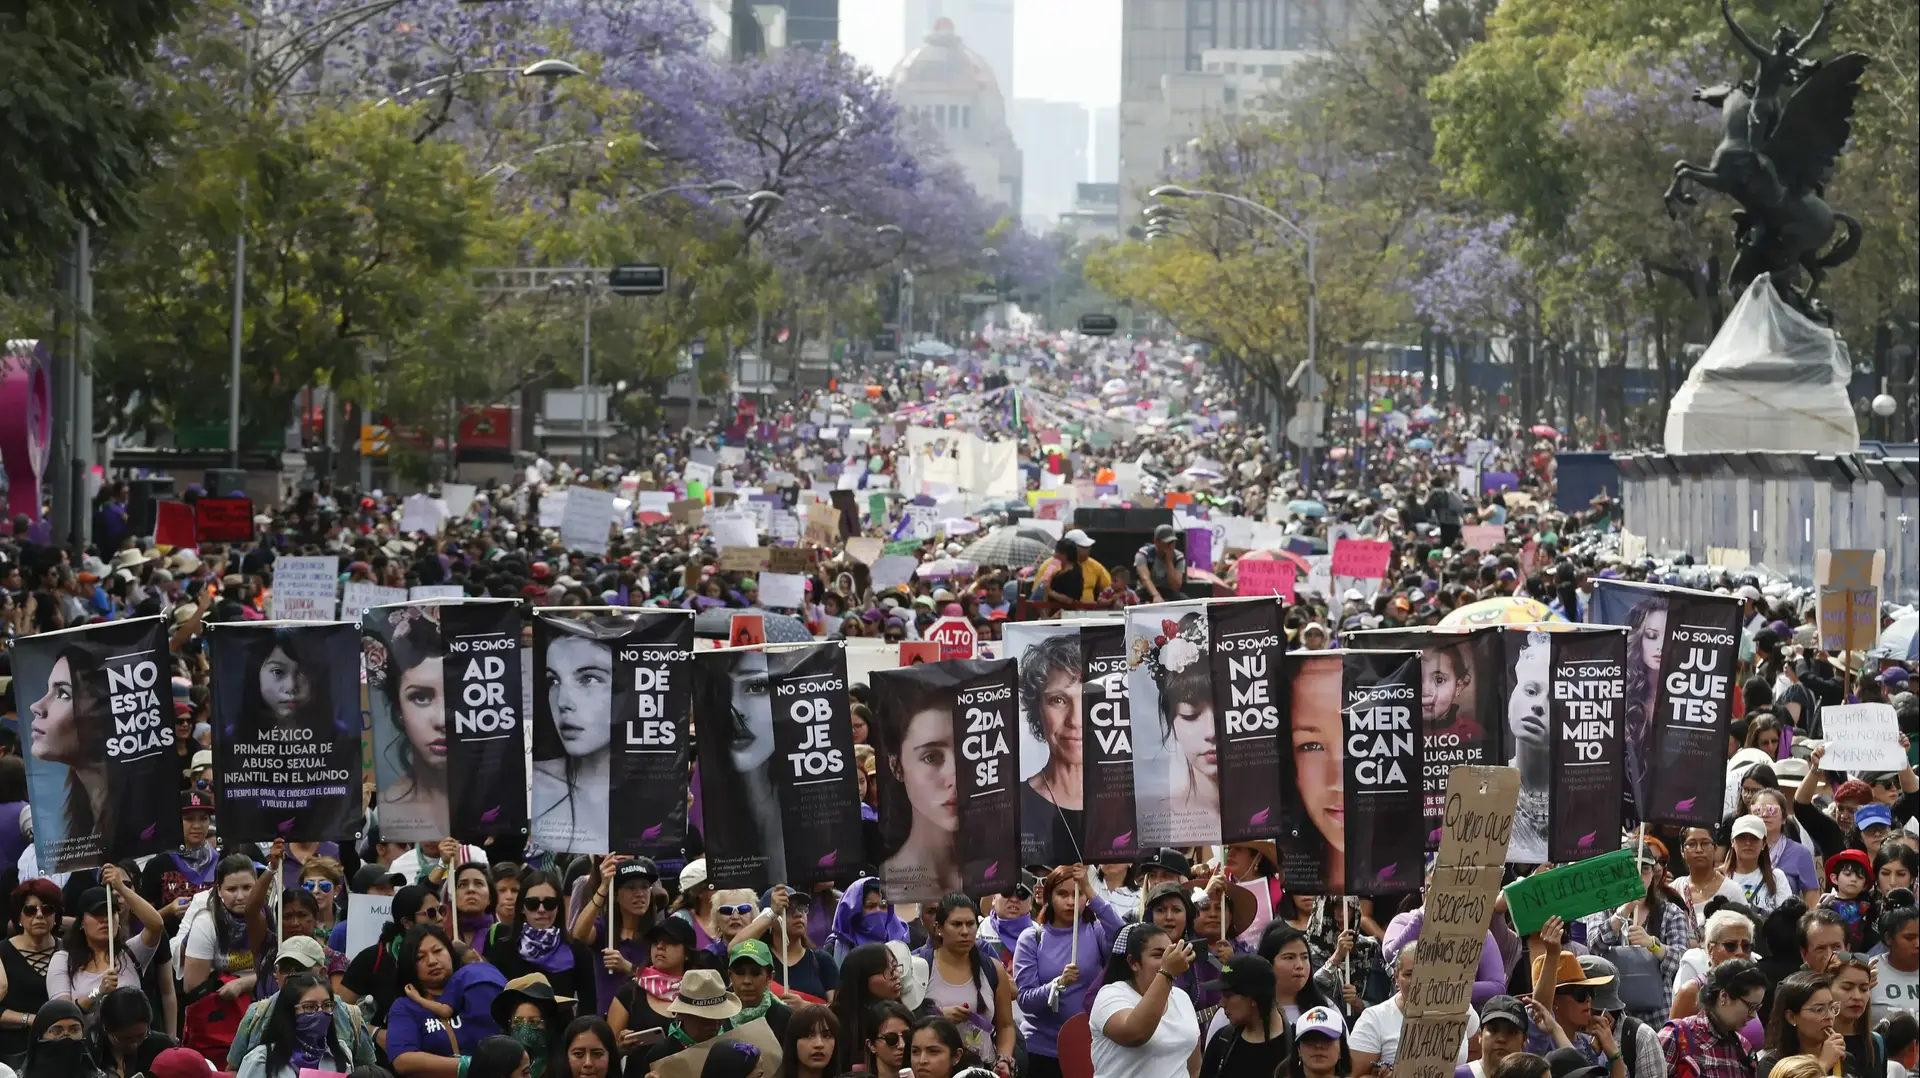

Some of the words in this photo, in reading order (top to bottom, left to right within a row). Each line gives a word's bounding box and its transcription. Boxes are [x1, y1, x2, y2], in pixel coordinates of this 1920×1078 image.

[450, 641, 468, 653] NO
[472, 639, 515, 651] SOMOS
[934, 629, 971, 646] ALTO
[1216, 641, 1234, 652] NO
[1238, 635, 1279, 650] SOMOS
[1671, 630, 1690, 642] NO
[1692, 631, 1735, 646] SOMOS
[620, 650, 639, 661] NO
[642, 650, 686, 661] SOMOS
[1089, 661, 1107, 673] NO
[1229, 648, 1267, 681] NÚ
[1679, 647, 1718, 672] JU
[106, 660, 158, 694] NO
[463, 656, 506, 681] AD
[635, 663, 670, 691] DÉ
[1557, 666, 1576, 678] NO
[1579, 666, 1621, 677] SOMOS
[463, 682, 506, 707] OR
[777, 684, 795, 696] NO
[799, 679, 843, 694] SOMOS
[957, 694, 973, 705] NO
[977, 687, 1011, 703] SOMOS
[1231, 680, 1270, 707] ME
[1348, 690, 1366, 702] NO
[1371, 688, 1414, 700] SOMOS
[1554, 680, 1624, 700] ENTRE
[1666, 671, 1728, 700] GUE
[110, 689, 161, 715] ESTA
[639, 694, 664, 718] BI
[790, 698, 833, 723] OB
[1565, 701, 1612, 720] TENI
[1668, 697, 1718, 724] TES
[114, 709, 161, 735] MOS
[455, 707, 516, 734] NOS
[965, 707, 1004, 733] 2DA
[1090, 702, 1131, 727] CL
[1225, 706, 1280, 735] ROS
[1349, 706, 1412, 731] MER
[106, 727, 174, 757] SOLAS
[258, 725, 313, 741] MÉXICO
[626, 721, 676, 745] LES
[798, 724, 832, 750] JE
[1095, 729, 1132, 755] VA
[1423, 734, 1460, 748] XICO
[1562, 721, 1614, 740] MIEN
[234, 744, 276, 755] PRIMER
[279, 743, 317, 755] LUGAR
[320, 742, 333, 753] DE
[962, 731, 1010, 761] CLA
[1347, 733, 1414, 758] CAN
[1424, 750, 1464, 763] LUGAR
[1467, 748, 1483, 760] DE
[1574, 742, 1603, 761] TO
[242, 758, 284, 769] ABUSO
[286, 757, 327, 769] SEXUAL
[787, 749, 844, 777] TOS
[976, 759, 999, 787] SE
[1355, 758, 1408, 785] CÍA
[224, 771, 270, 783] INFANTIL
[273, 772, 288, 783] EN
[291, 772, 303, 783] EL
[306, 769, 349, 782] MUNDO
[190, 793, 201, 805] LA
[227, 789, 233, 798] ES
[233, 789, 251, 797] TIEMPO
[252, 788, 259, 797] DE
[278, 789, 286, 797] DE
[315, 787, 322, 796] EL
[323, 786, 346, 795] CAMINO
[261, 799, 266, 807] Y
[267, 800, 287, 808] VOLVER
[287, 800, 295, 808] AL
[1426, 796, 1435, 805] DE
[1484, 811, 1512, 854] que
[370, 905, 393, 915] MUJ
